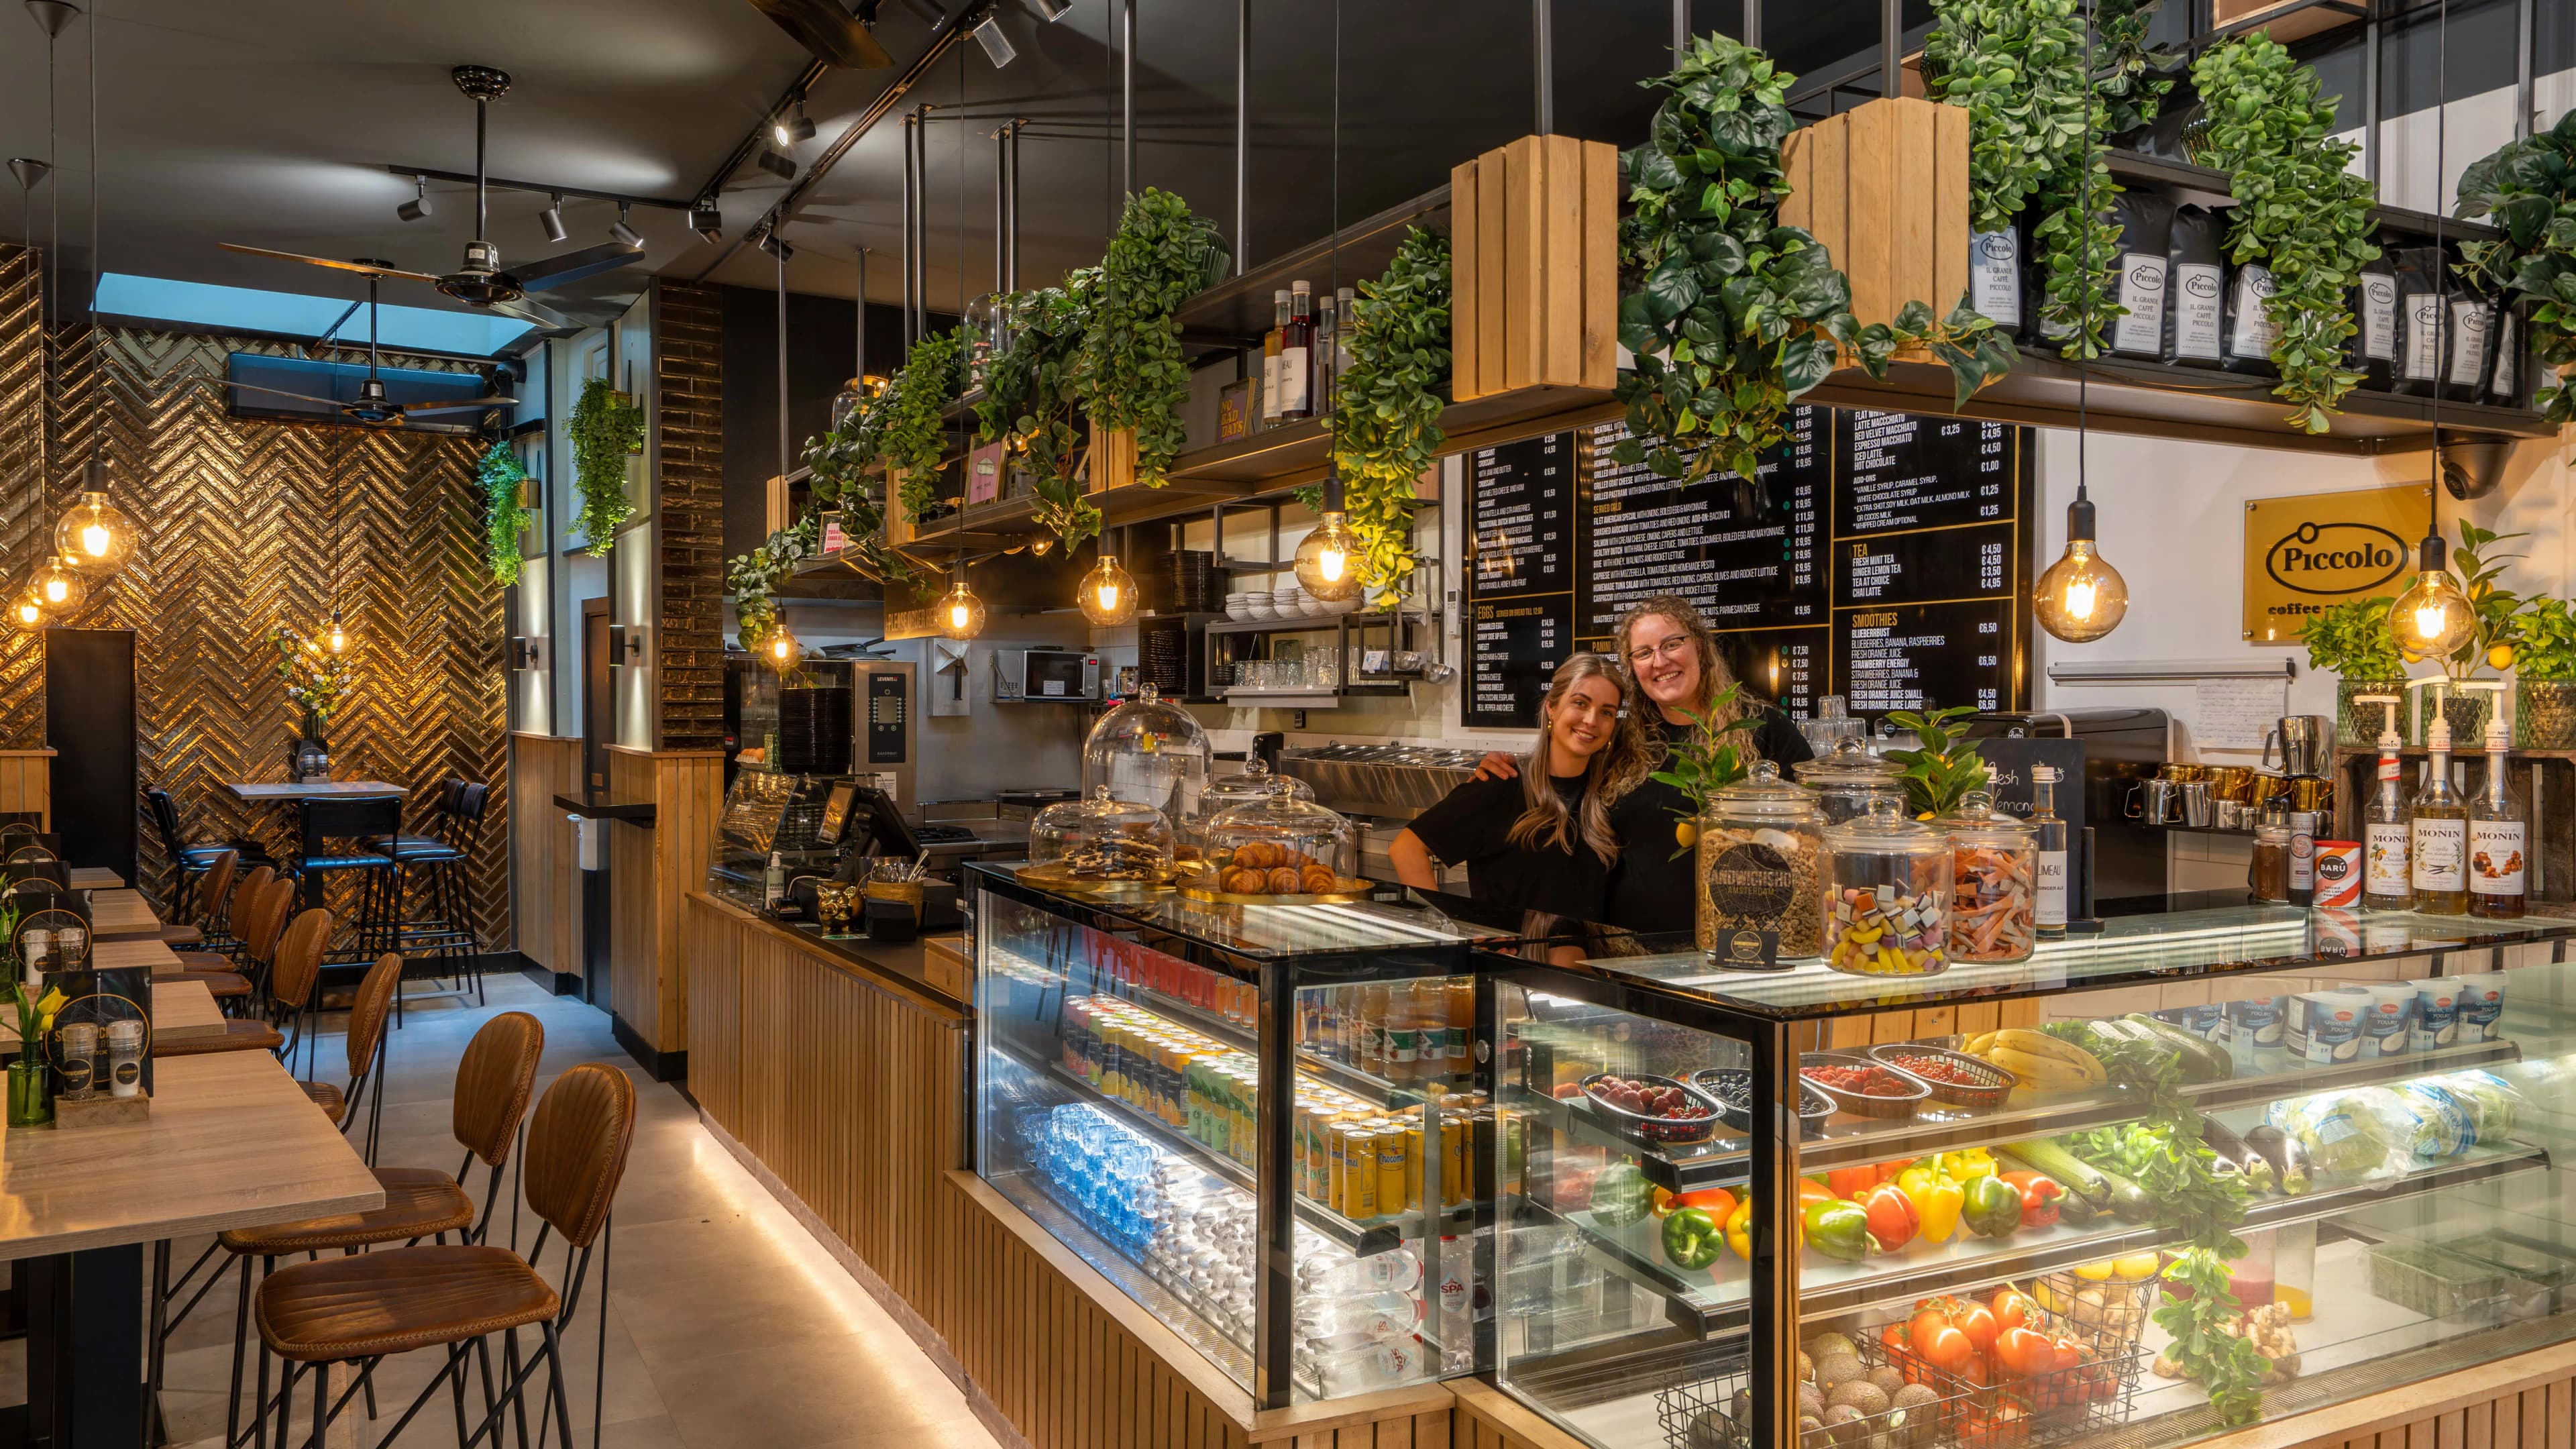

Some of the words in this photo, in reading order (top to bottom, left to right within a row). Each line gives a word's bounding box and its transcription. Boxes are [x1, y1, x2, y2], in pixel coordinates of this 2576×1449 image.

[1986, 243, 2012, 253] Piccolo
[2135, 272, 2161, 284] Piccolo
[2192, 282, 2216, 291] Piccolo
[2257, 283, 2277, 292] Picco
[2372, 288, 2392, 299] Piccolo
[2133, 313, 2155, 321] PICCOLO
[1222, 399, 1232, 414] NO
[1222, 410, 1238, 426] BAD
[1855, 419, 1870, 431] LATTE
[1872, 414, 1904, 427] MACCCHIATO
[1222, 421, 1242, 439] DAYS
[1855, 431, 1865, 441] RED
[1866, 427, 1885, 439] VELVET
[1886, 421, 1917, 435] MACCHIATO
[1855, 439, 1880, 451] ESPRESSO
[1882, 433, 1912, 447] MACCHIATO
[1855, 451, 1866, 461] ICED
[1867, 449, 1883, 460] LATTE
[1855, 462, 1864, 470] HOT
[1866, 456, 1896, 469] CHOCOLATE
[1982, 460, 1999, 472] €1,00
[1594, 480, 1609, 490] GRILLED
[1619, 477, 1633, 486] CHEESE
[1854, 475, 1876, 484] ADD-ONS
[1895, 478, 1919, 488] CARAMEL
[1594, 491, 1609, 501] GRILLED
[1609, 489, 1627, 498] PASTRAMI
[1872, 491, 1900, 501] CHOCOLATE
[1900, 488, 1917, 497] SYRUP
[1980, 484, 1998, 496] €1,25
[1935, 492, 1956, 502] ALMOND
[1957, 490, 1970, 500] MILK
[1594, 504, 1610, 514] SERVED
[1980, 505, 1998, 517] €1,25
[1864, 513, 1879, 521] COCOS
[1880, 511, 1891, 519] MILK
[1877, 518, 1894, 527] CREAM
[1894, 516, 1918, 525] OPTIONAL
[1594, 527, 1611, 537] SMASHED
[1611, 525, 1628, 535] AVOCADO
[1853, 543, 1868, 557] TEA
[1853, 556, 1869, 567] FRESH
[1870, 555, 1883, 565] MINT
[1884, 554, 1894, 564] TEA
[2284, 543, 2394, 571] Piccolo
[1594, 572, 1610, 580] CAPRESE
[1853, 567, 1871, 577] GINGER
[1872, 565, 1890, 576] LEMON
[1891, 564, 1901, 574] TEA
[1853, 578, 1863, 587] TEA
[1863, 577, 1870, 586] AT
[1871, 576, 1890, 585] CHOICE
[1685, 586, 1700, 595] ROCKET
[1701, 584, 1719, 593] LETTUCE
[1853, 588, 1865, 597] CHAI
[1866, 587, 1881, 596] LATTE
[1479, 605, 1494, 620] EGGS
[2268, 603, 2320, 615] coffee
[908, 609, 924, 630] ORDER
[1852, 612, 1898, 628] SMOOTHIES
[1979, 623, 1996, 633] €6,50
[1593, 641, 1611, 652] PANINI
[1909, 636, 1945, 646] RASPBERRIES
[1851, 649, 1867, 659] FRESH
[1868, 649, 1888, 658] ORANGE
[1888, 648, 1902, 658] JUICE
[1851, 659, 1886, 669] STRAWBERRY
[1979, 656, 1996, 667] €6,50
[1892, 669, 1913, 678] BANANA
[1915, 668, 1918, 678] &
[1851, 680, 1867, 689] FRESH
[1868, 680, 1888, 688] ORANGE
[1889, 680, 1902, 688] JUICE
[1851, 690, 1867, 699] FRESH
[1868, 690, 1889, 699] ORANGE
[1890, 690, 1904, 698] JUICE
[1905, 690, 1923, 698] SMALL
[1979, 690, 1996, 699] €4,50
[1851, 700, 1867, 710] FRESH
[1868, 700, 1889, 710] ORANGE
[1890, 700, 1904, 710] JUICE
[1905, 700, 1921, 709] LARGE
[1979, 700, 1996, 710] €6,50
[1996, 789, 2034, 811] lemon
[2418, 829, 2460, 837] MONIN
[2477, 832, 2520, 841] MONIN
[2320, 862, 2346, 872] BARÚ
[1711, 870, 1792, 887] ANDWICHSHO
[1728, 886, 1774, 896] AMSTERDAM
[1379, 1152, 1407, 1165] Chocome
[1440, 1284, 1464, 1293] SPA
[1391, 1348, 1403, 1372] SPA
